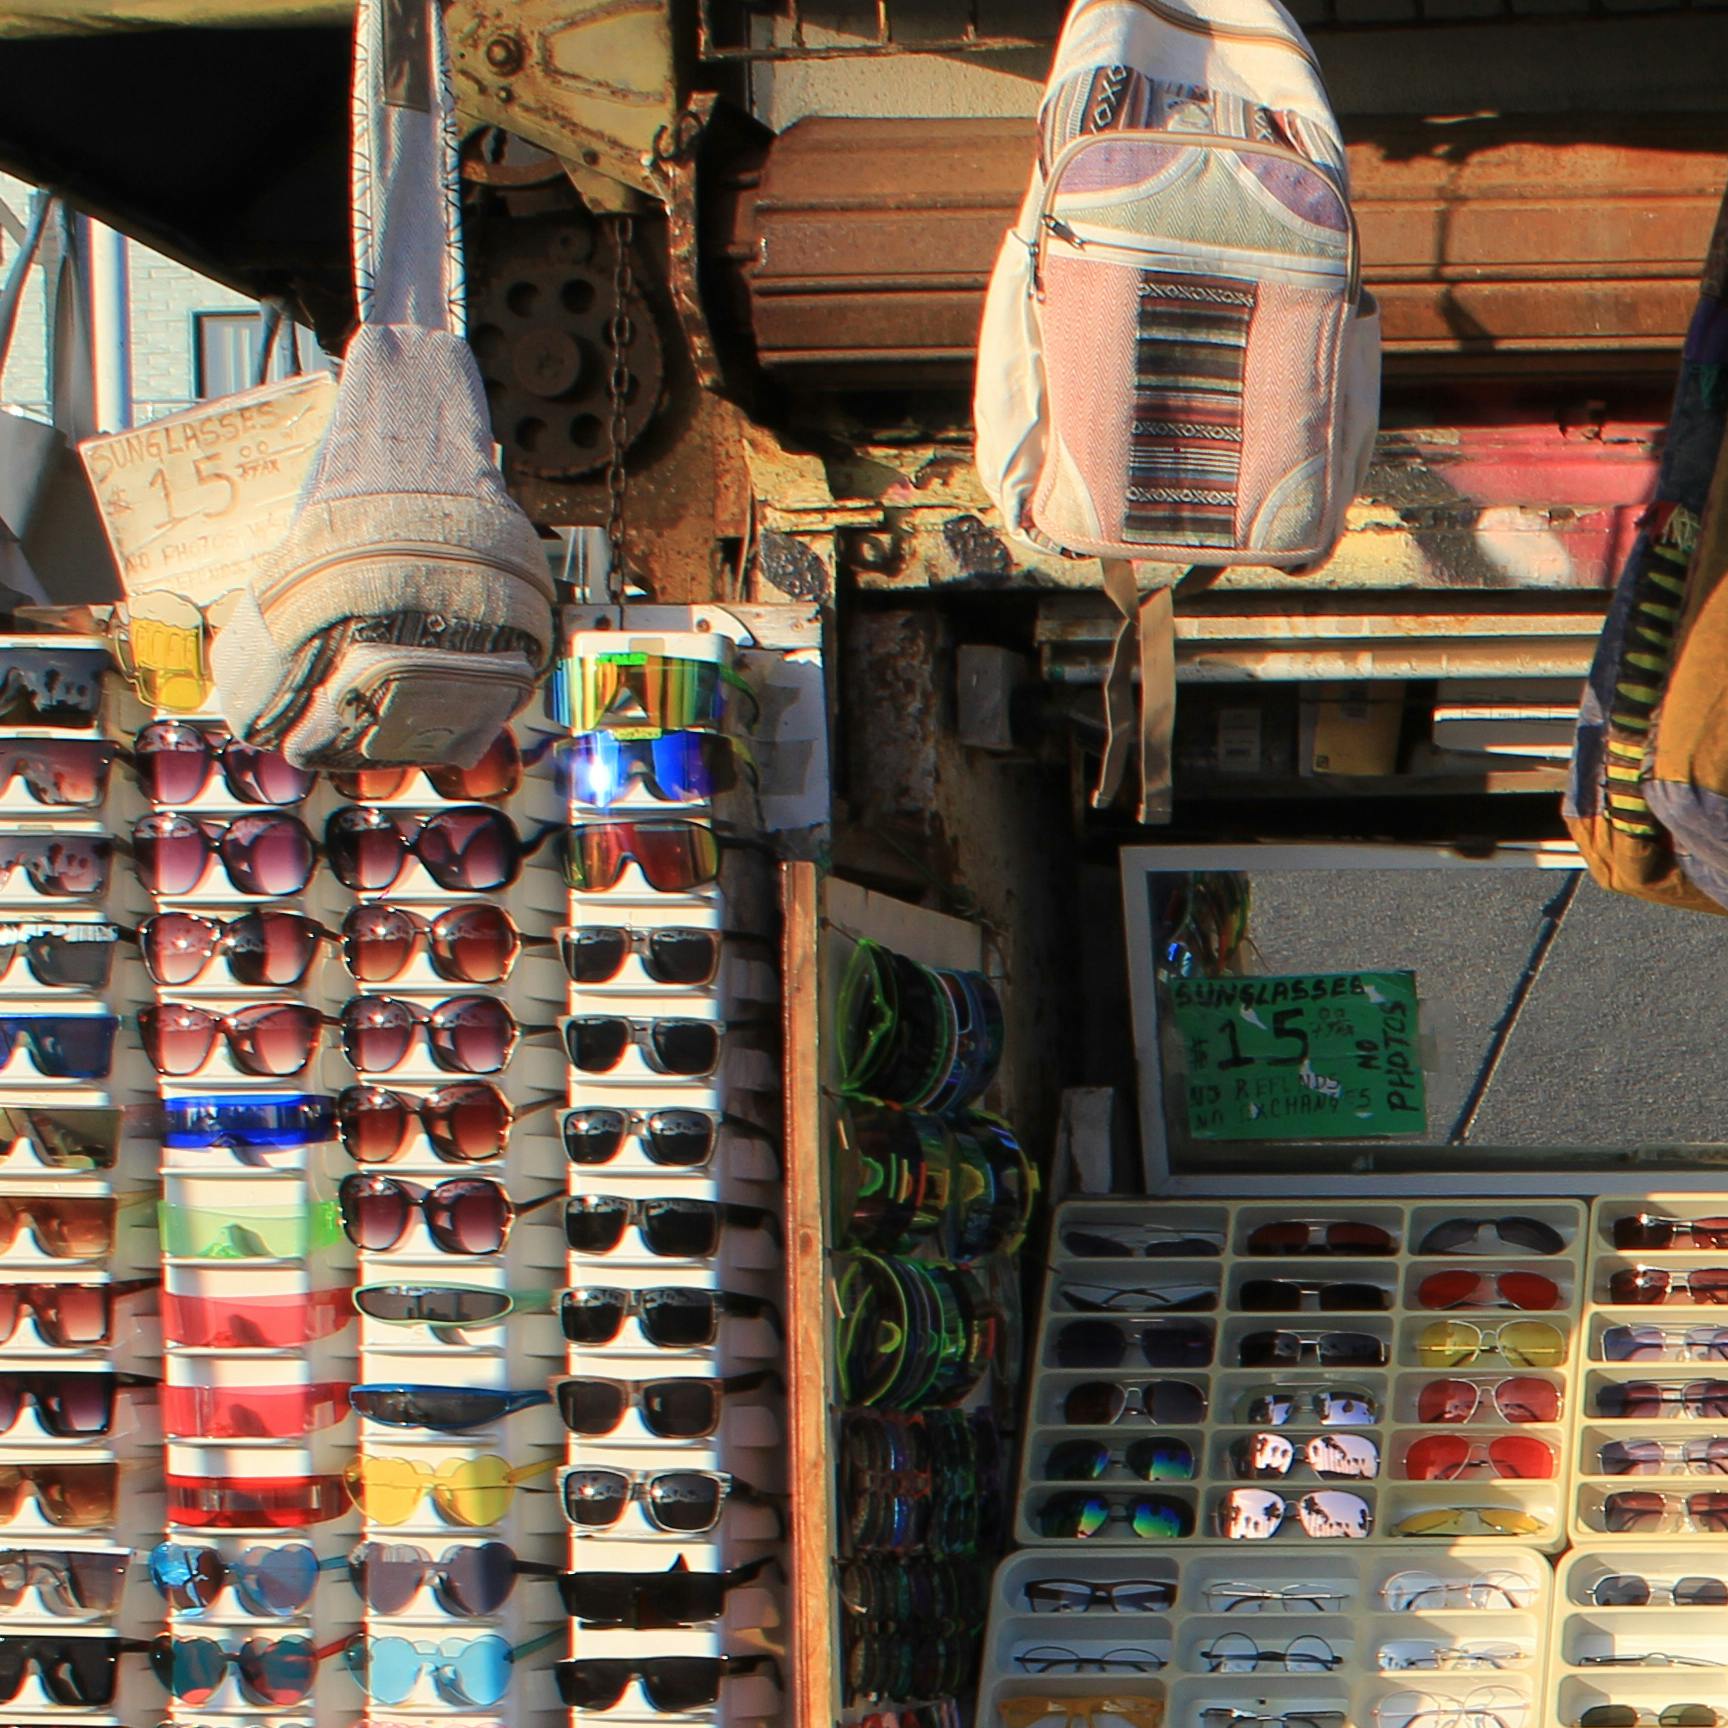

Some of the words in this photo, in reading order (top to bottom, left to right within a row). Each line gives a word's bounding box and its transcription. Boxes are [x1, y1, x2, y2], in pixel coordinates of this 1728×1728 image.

[90, 402, 277, 484] SUNGLASSES
[149, 453, 240, 530] 15
[1174, 975, 1367, 1008] SUNGLASSES
[1217, 1007, 1310, 1072] 15
[1382, 1000, 1420, 1112] PHOTOS
